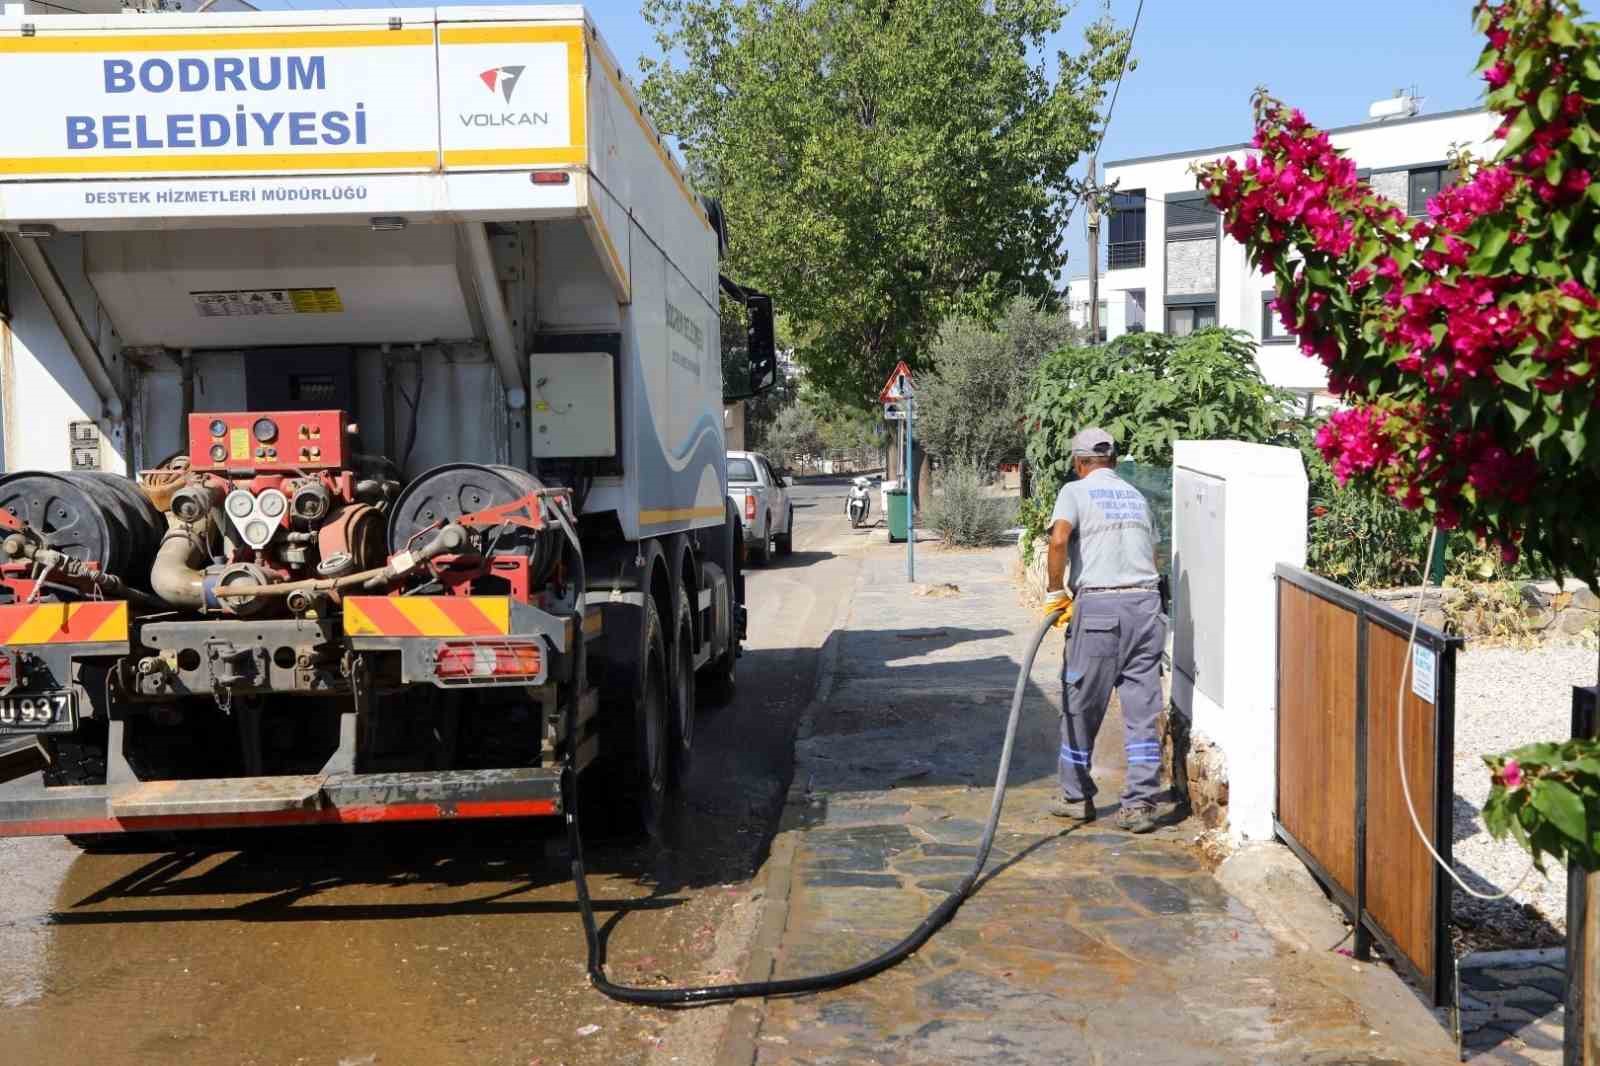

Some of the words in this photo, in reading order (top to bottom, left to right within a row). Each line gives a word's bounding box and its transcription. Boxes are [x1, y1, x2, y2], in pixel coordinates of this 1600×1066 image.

[104, 56, 326, 93] BODRUM
[66, 102, 367, 149] BELEDİYESİ
[459, 111, 548, 127] VOLKAN
[85, 191, 151, 204] DESTEK
[156, 187, 256, 203] HİZMETLERİ
[261, 185, 368, 201] MÜDÜRLÜĞÜ
